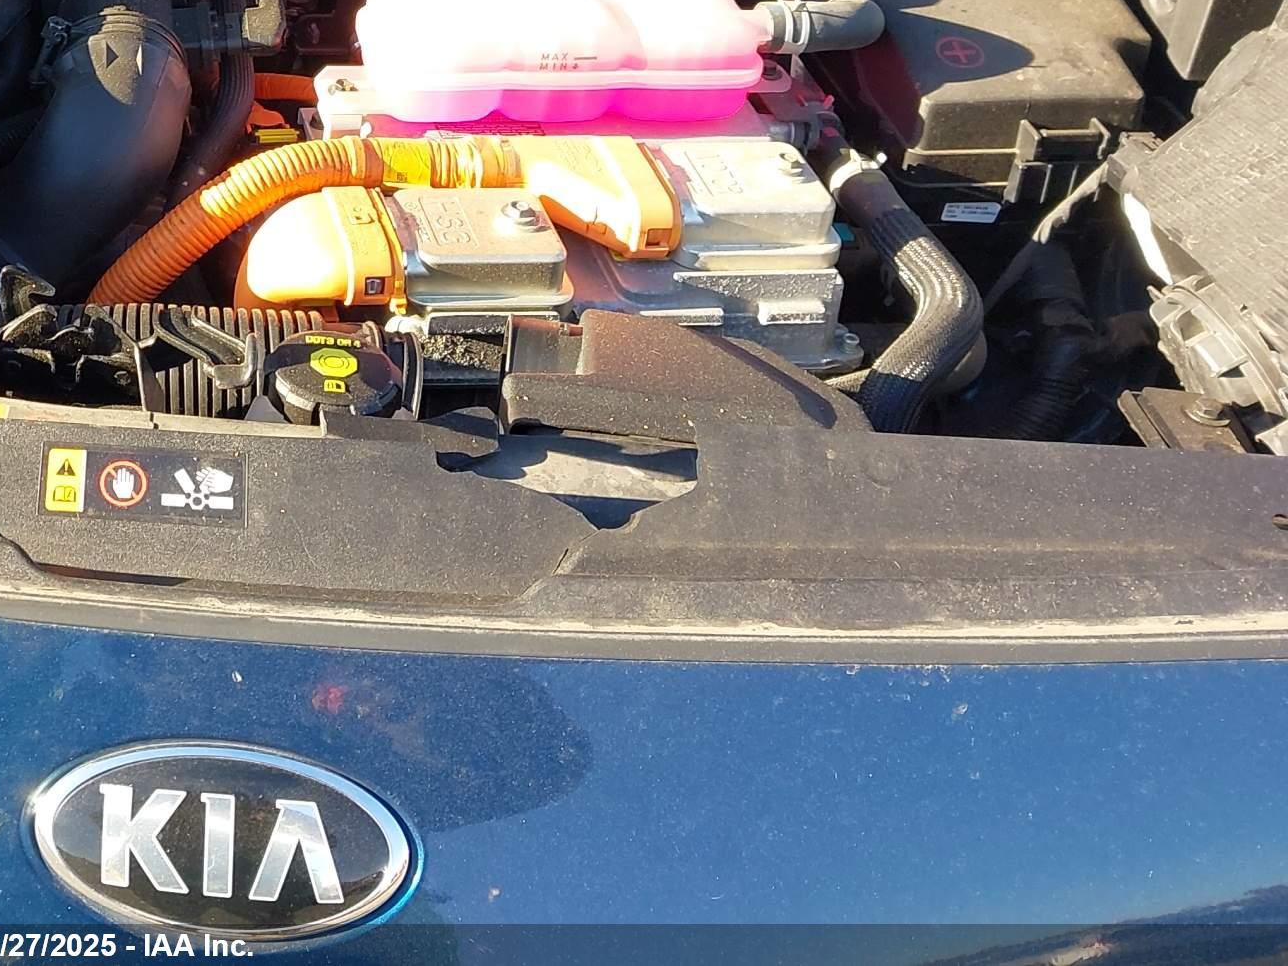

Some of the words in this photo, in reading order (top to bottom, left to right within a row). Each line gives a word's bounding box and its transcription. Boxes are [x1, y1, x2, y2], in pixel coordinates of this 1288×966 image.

[541, 52, 569, 62] MAX
[539, 62, 568, 71] MIN
[305, 335, 335, 346] DOT3
[336, 338, 352, 347] OR
[353, 339, 362, 349] 4
[99, 782, 345, 905] KIA
